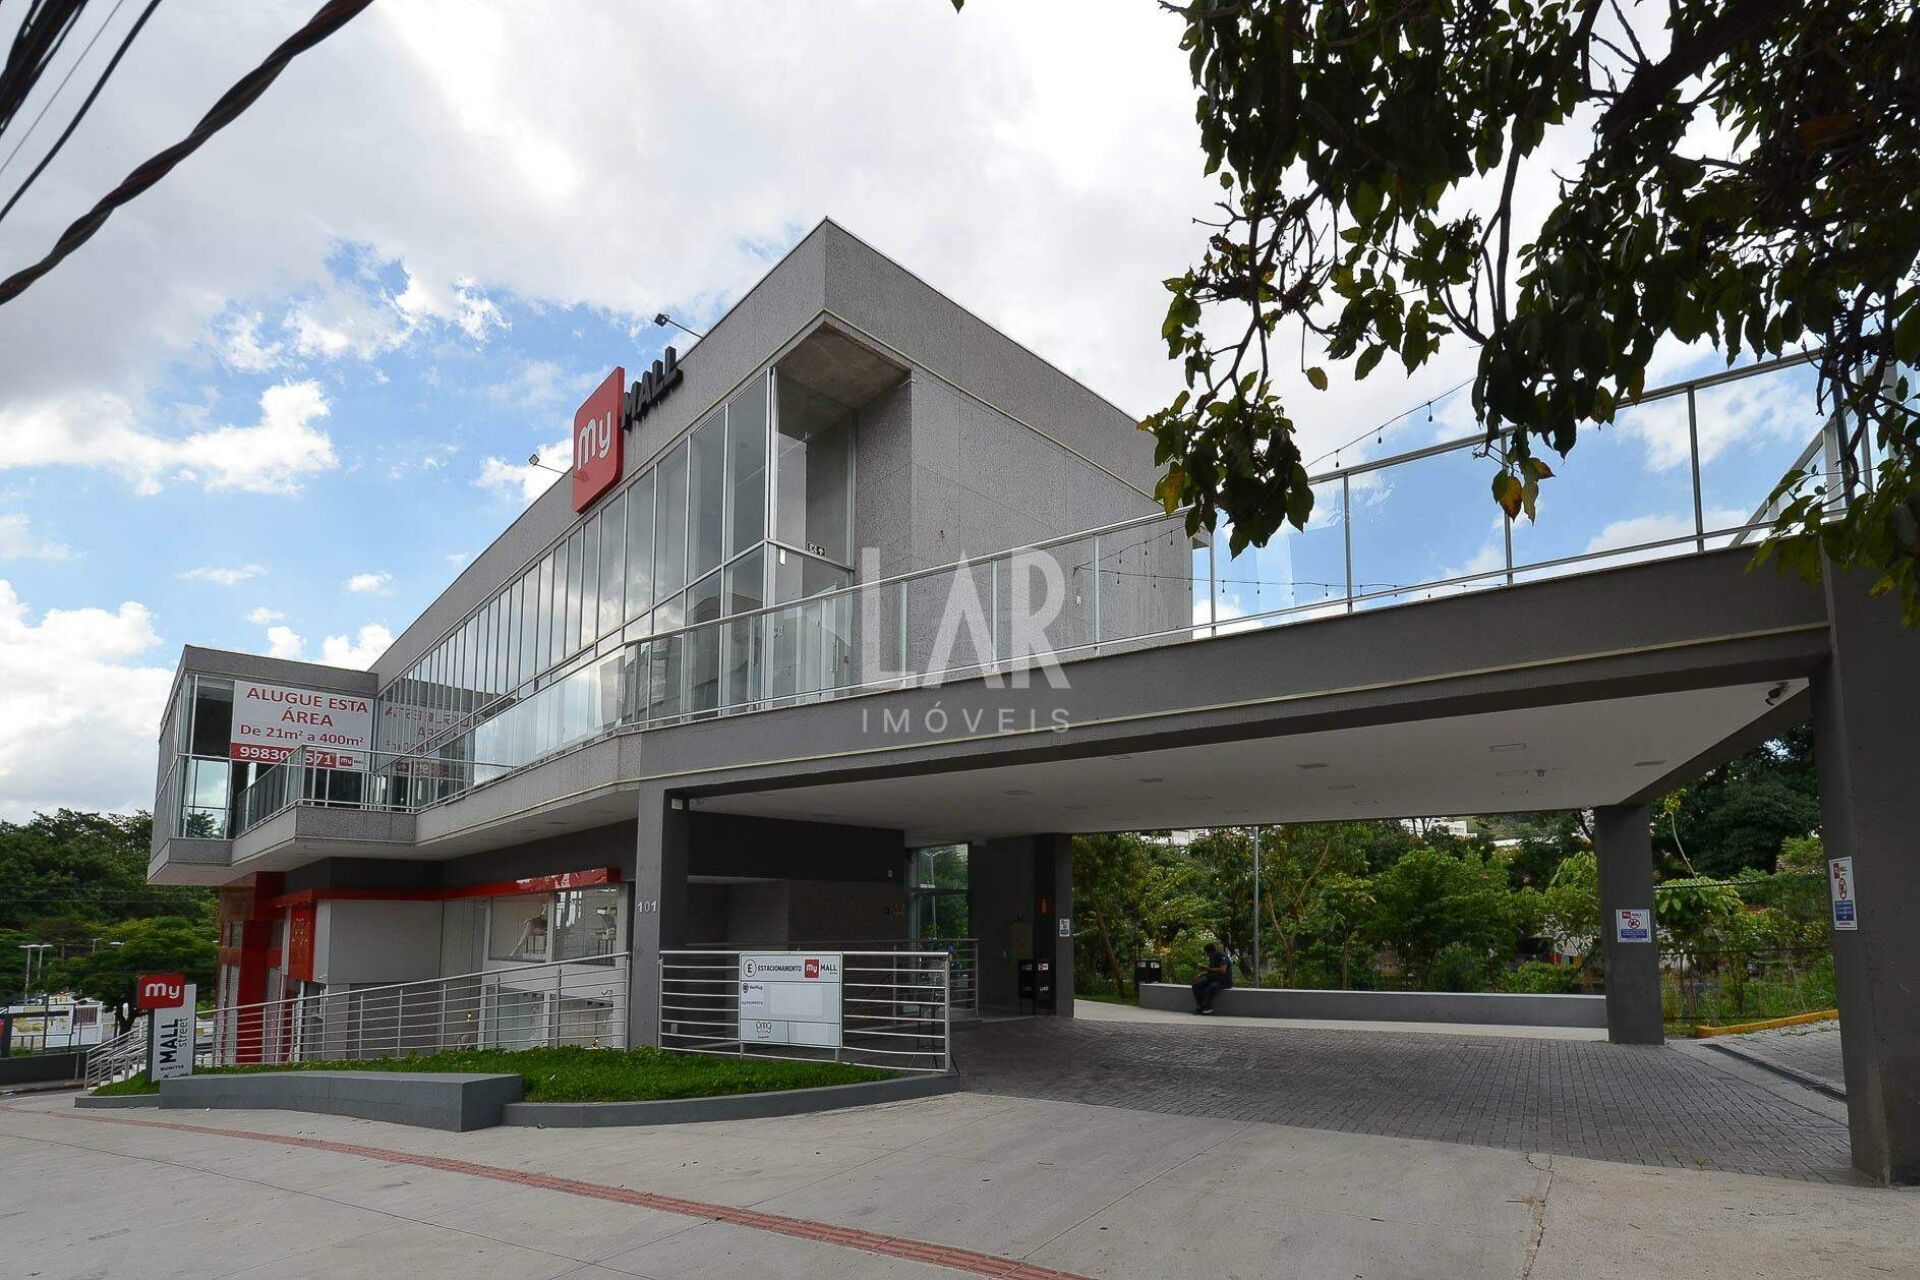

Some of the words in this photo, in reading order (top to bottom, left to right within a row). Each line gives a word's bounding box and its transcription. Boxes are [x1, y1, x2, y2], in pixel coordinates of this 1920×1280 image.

[577, 411, 611, 471] my
[622, 346, 684, 432] MALL
[246, 687, 323, 707] ALUGUE
[329, 697, 368, 713] ESTA
[281, 707, 333, 727] ÁREA
[240, 724, 261, 737] De
[266, 727, 303, 740] 21m²
[307, 733, 315, 742] a
[319, 733, 364, 747] 400m²
[637, 901, 657, 912] 101
[747, 963, 753, 974] E
[758, 964, 802, 972] ESTACIONAMENTO
[806, 963, 818, 973] my
[820, 964, 837, 972] MALL
[145, 982, 180, 999] my
[159, 1019, 179, 1064] MALL
[178, 1017, 188, 1048] street
